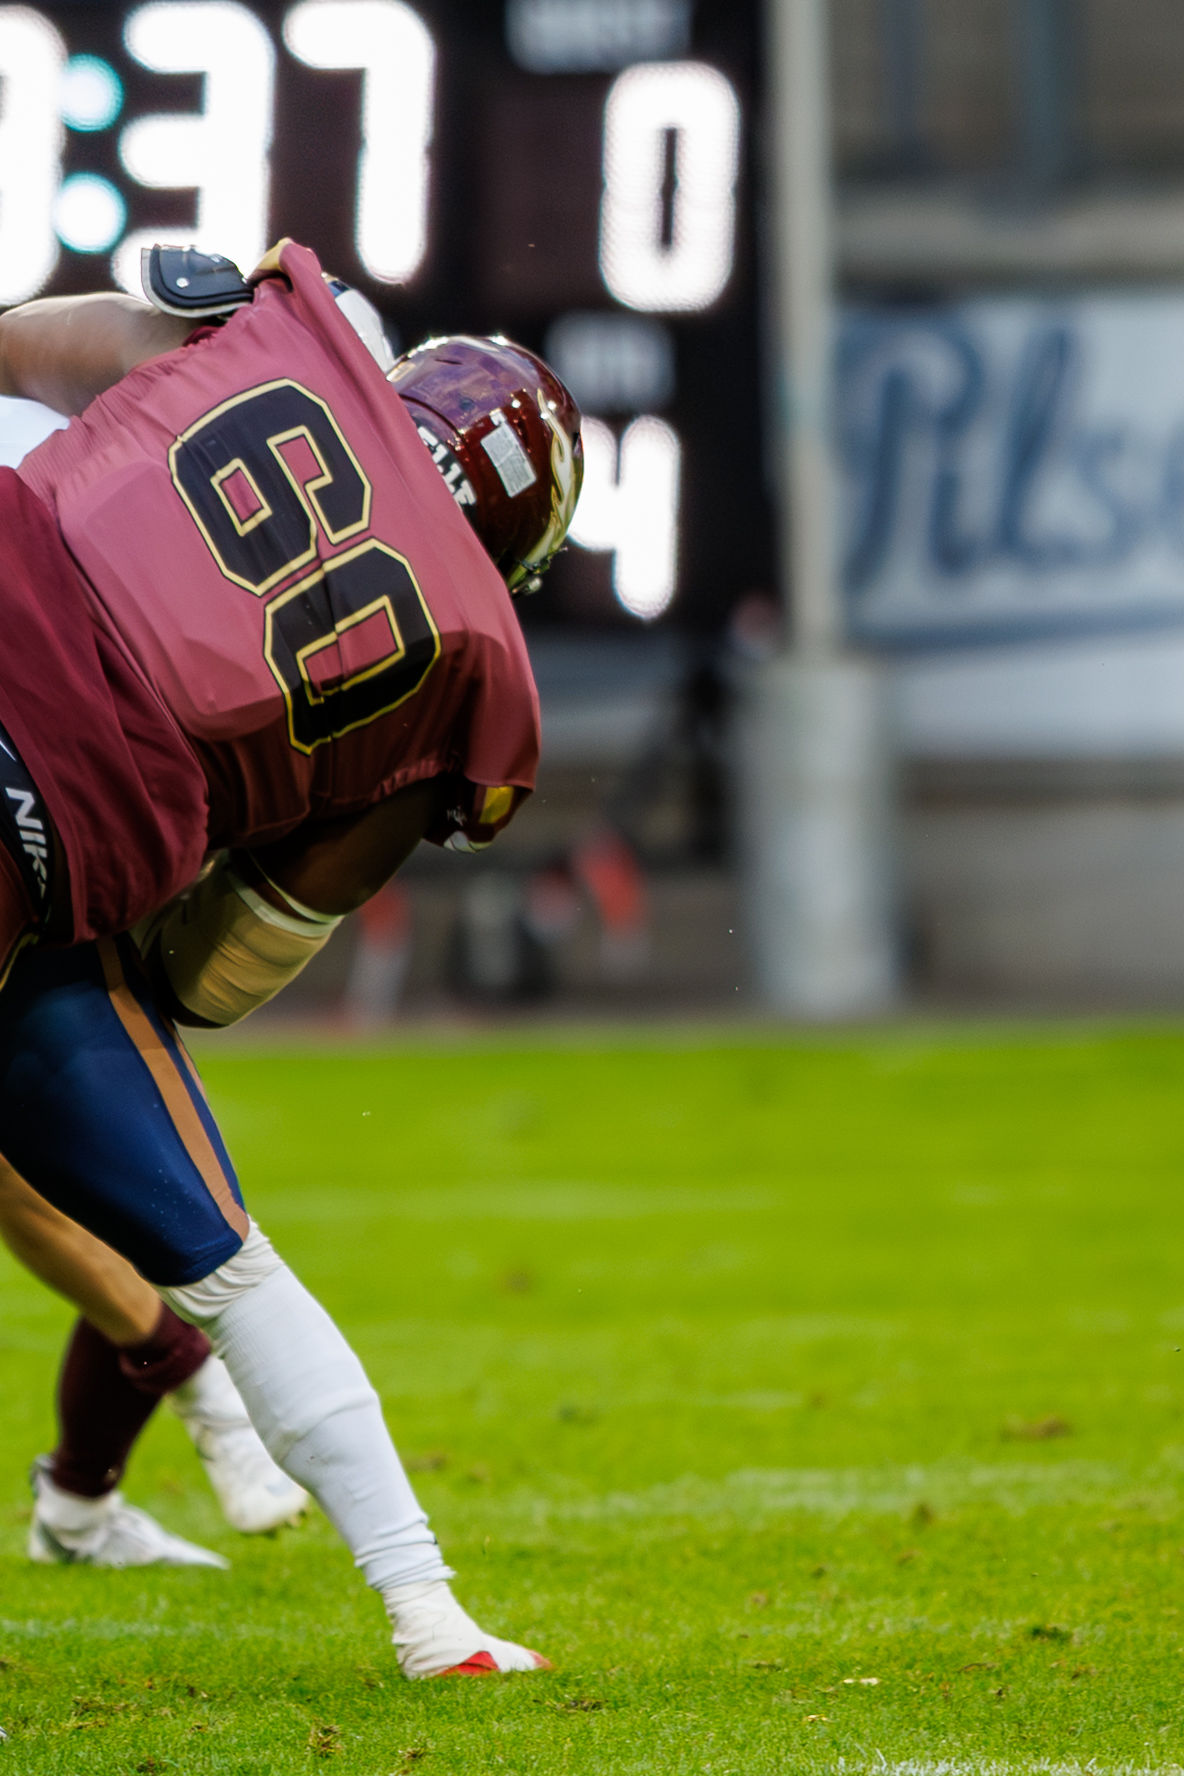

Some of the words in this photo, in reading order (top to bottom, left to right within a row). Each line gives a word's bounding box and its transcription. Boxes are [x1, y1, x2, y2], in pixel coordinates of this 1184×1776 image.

[599, 60, 740, 312] 0
[168, 377, 441, 756] 60
[568, 414, 681, 620] 4
